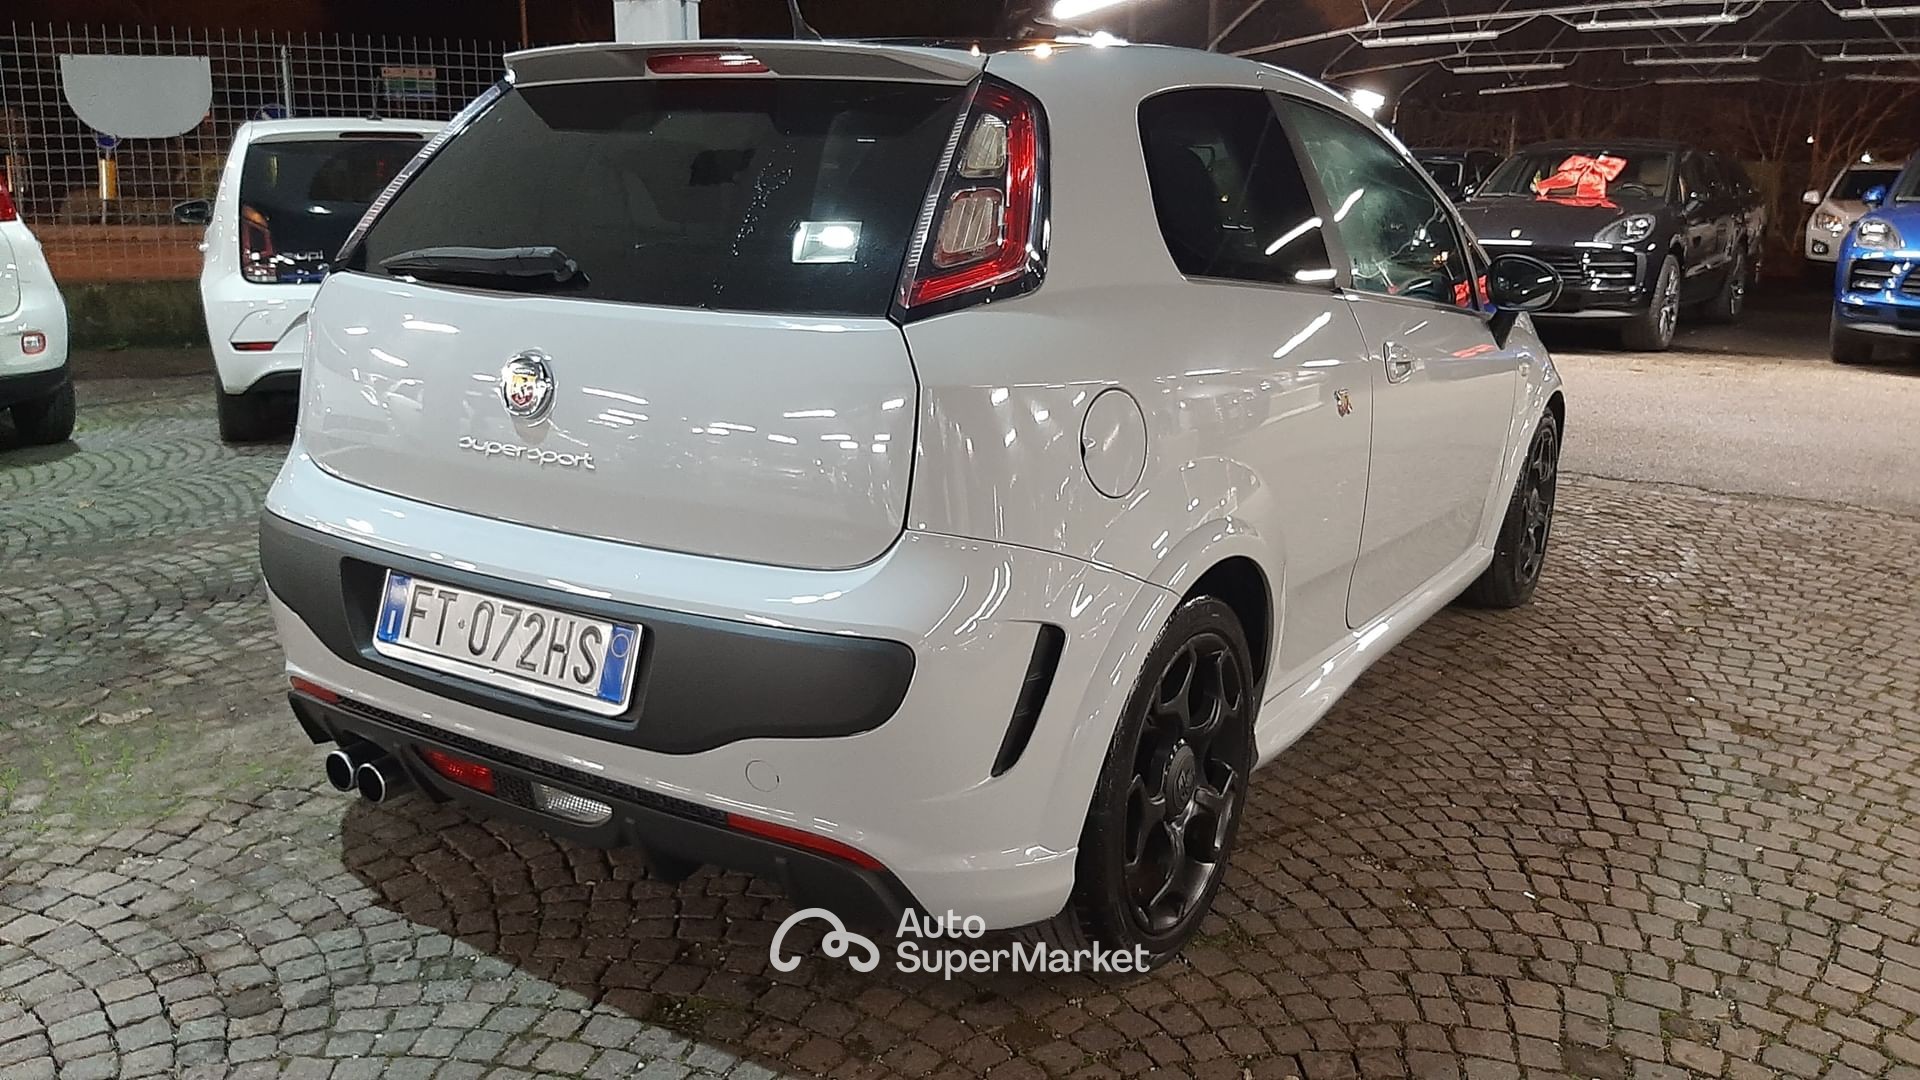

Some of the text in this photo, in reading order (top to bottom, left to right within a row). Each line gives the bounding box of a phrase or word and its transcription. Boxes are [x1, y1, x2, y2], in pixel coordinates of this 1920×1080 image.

[459, 436, 596, 470] supersport
[405, 583, 459, 647] FT
[468, 599, 602, 685] 072HS
